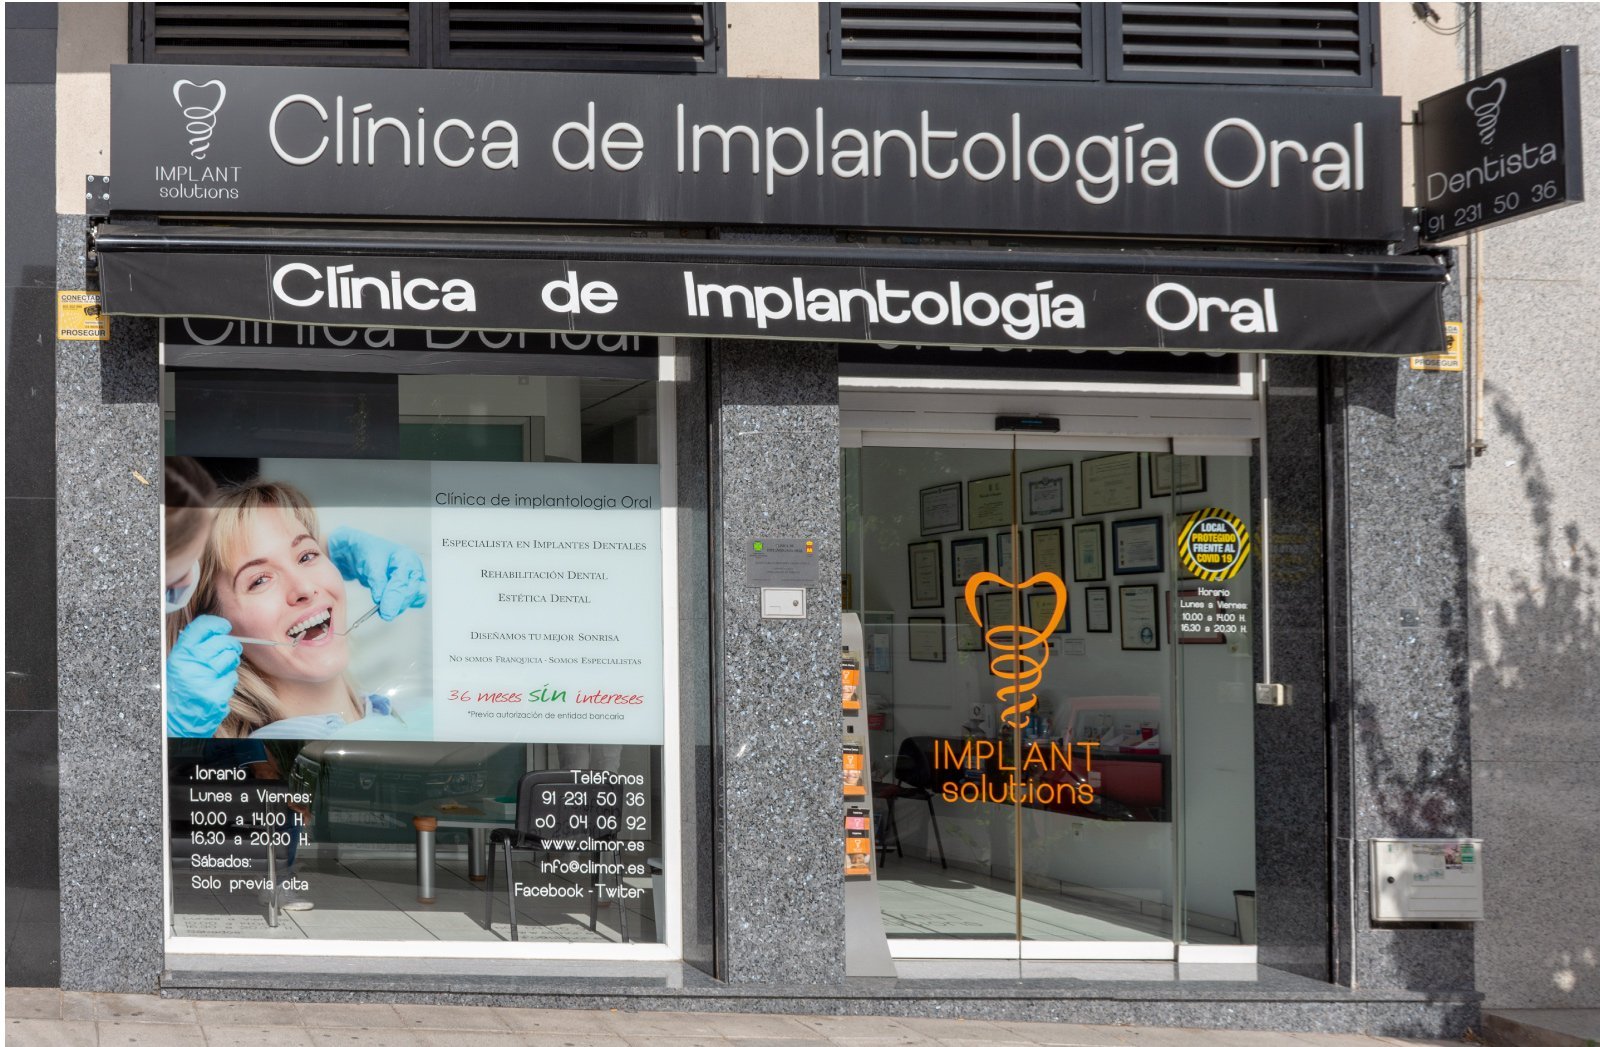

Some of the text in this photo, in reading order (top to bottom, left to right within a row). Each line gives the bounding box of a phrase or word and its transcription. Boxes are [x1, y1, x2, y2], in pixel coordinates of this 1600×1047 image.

[269, 93, 1364, 204] Clínica de Implantología Oral
[155, 166, 242, 182] IMPLANT
[1427, 142, 1557, 201] Dentista
[159, 183, 239, 199] solutions
[1428, 180, 1557, 233] 91 231 50 36
[272, 262, 477, 312] Clínica
[541, 270, 618, 314] de
[683, 271, 1086, 341] Implantología
[1146, 282, 1279, 333] Oral
[61, 329, 106, 337] PROSEGUR
[435, 492, 486, 506] Clínica
[490, 494, 510, 506] de
[621, 496, 652, 509] Oral
[1201, 523, 1227, 532] LOCAL
[442, 538, 647, 551] ESPECIALISTA EN IMPLANTES DENTALES
[1192, 533, 1236, 543] PROTEGIDO
[1193, 543, 1235, 553] FRENTE AL
[1197, 554, 1233, 563] COVID 19
[481, 569, 608, 580] REHABILITACIÓN DENTAL
[498, 593, 591, 604] ESTÉTICA DENTAL
[1198, 587, 1230, 597] Horario
[1180, 600, 1205, 608] Lunes
[1216, 600, 1248, 610] Viernes:
[470, 631, 526, 641] DISEÑAMOS
[578, 633, 620, 642] SONRISA
[449, 654, 463, 663] NO
[495, 656, 543, 665] FRANQUICIA
[581, 657, 642, 665] ESPECIALISTAS
[448, 690, 472, 702] 36
[477, 690, 523, 703] meses
[576, 690, 644, 705] intereses
[496, 711, 543, 719] autorización
[544, 711, 556, 720] de
[557, 711, 588, 720] entidad
[589, 712, 625, 720] bancaria
[934, 740, 1100, 771] IMPLANT
[570, 770, 644, 785] Teléfonos
[190, 788, 312, 804] Lunes a Viernes:
[942, 773, 1094, 804] solutions
[542, 791, 645, 806] 91 231 50 36
[236, 815, 243, 826] a
[294, 812, 305, 827] H.
[569, 815, 588, 829] 04
[597, 816, 617, 830] 06
[626, 816, 647, 831] 92
[234, 835, 242, 845] a
[299, 833, 311, 846] H.
[541, 837, 645, 851] www.climor.es
[191, 854, 251, 868] Sábados:
[541, 859, 645, 874] info@climor.es
[191, 876, 309, 893] Solo previa cita
[514, 882, 584, 898] Facebook
